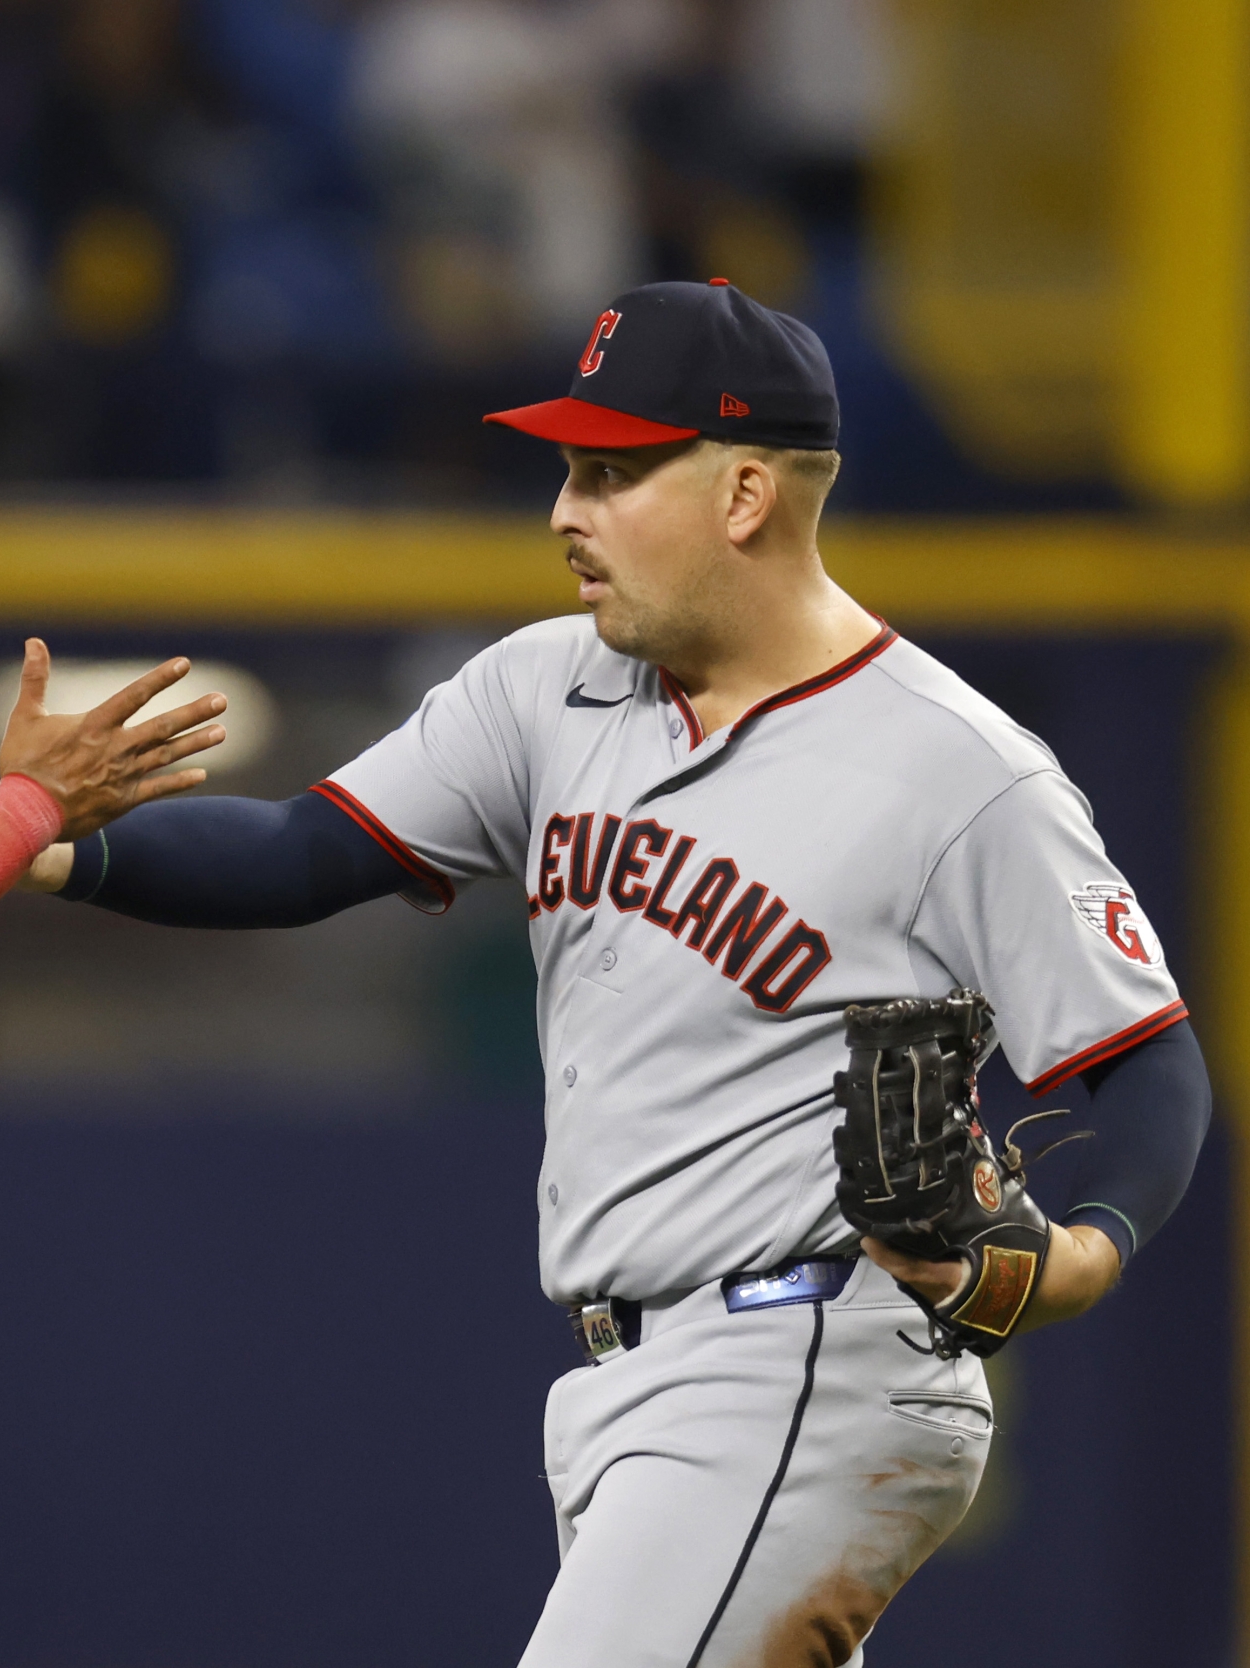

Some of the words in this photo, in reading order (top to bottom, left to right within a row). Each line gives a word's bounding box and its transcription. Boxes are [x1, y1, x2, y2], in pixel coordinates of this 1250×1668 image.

[578, 308, 623, 377] C
[528, 811, 832, 1013] EVELAND
[591, 1317, 614, 1349] 46
